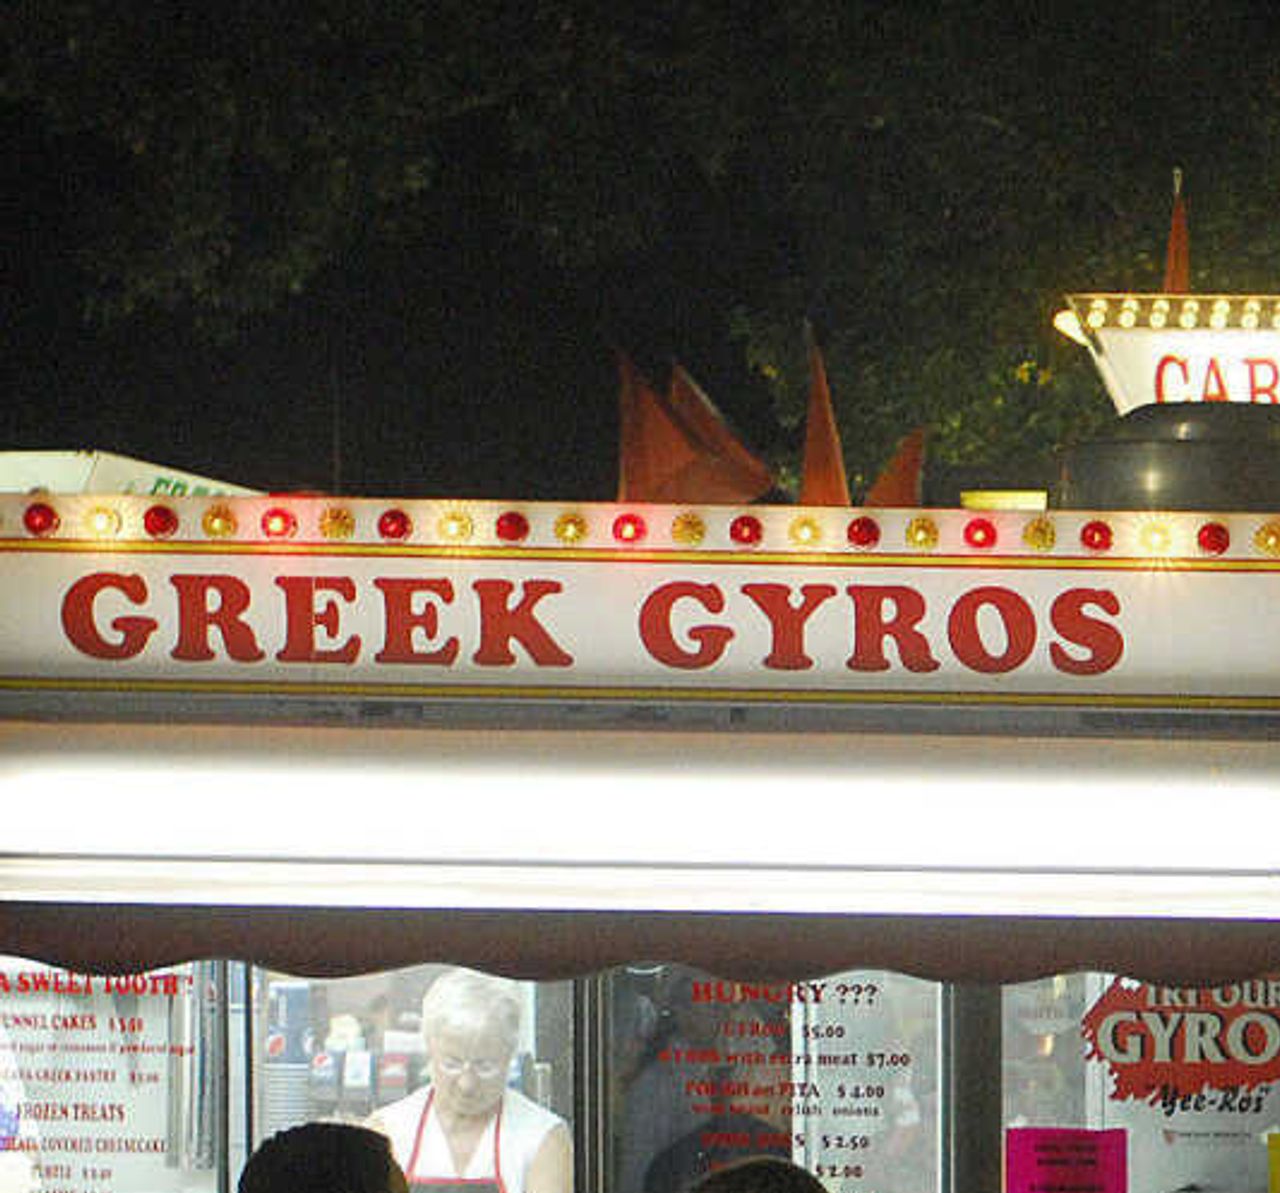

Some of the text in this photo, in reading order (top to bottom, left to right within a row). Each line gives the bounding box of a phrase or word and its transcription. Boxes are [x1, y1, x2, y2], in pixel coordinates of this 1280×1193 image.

[60, 571, 1126, 676] GREEK GYROS
[691, 981, 826, 1004] HUNGRY
[866, 1053, 911, 1069] $7.00
